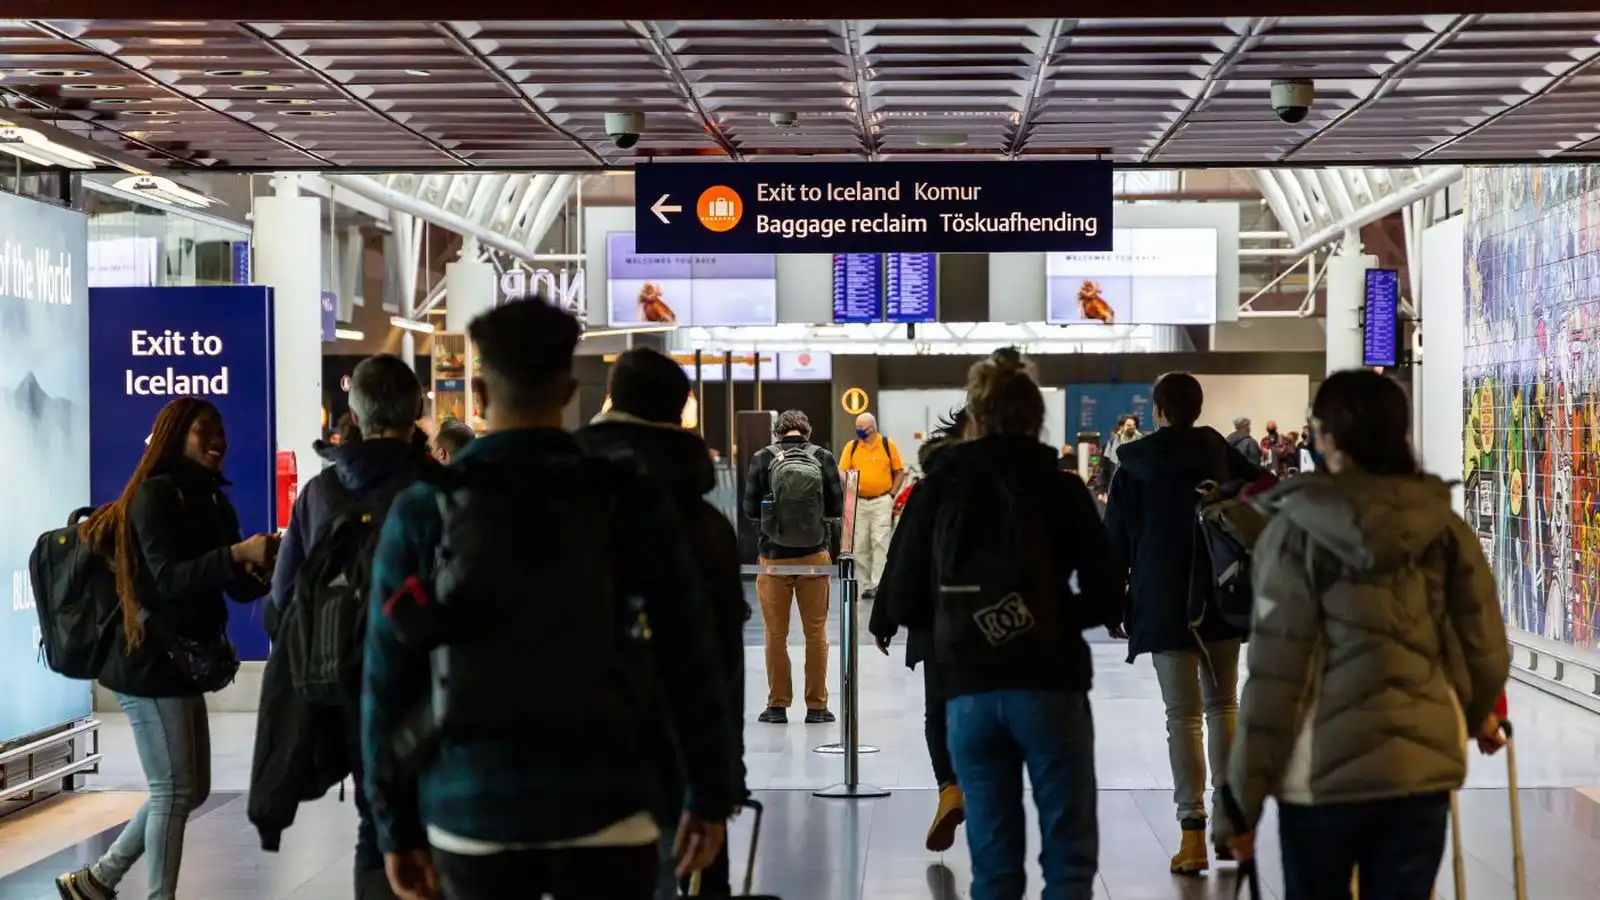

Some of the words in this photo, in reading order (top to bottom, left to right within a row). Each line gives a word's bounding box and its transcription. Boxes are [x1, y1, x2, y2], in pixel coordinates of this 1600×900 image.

[757, 182, 796, 202] Exit
[799, 183, 822, 202] to
[827, 180, 900, 201] Iceland
[915, 182, 982, 201] Komur
[756, 214, 847, 239] Baggage
[851, 212, 927, 233] reclaim
[939, 211, 1098, 237] Töskuafhending
[13, 244, 33, 299] the
[35, 247, 72, 305] World
[131, 329, 186, 356] Exit
[190, 331, 222, 356] to
[125, 366, 229, 396] Iceland
